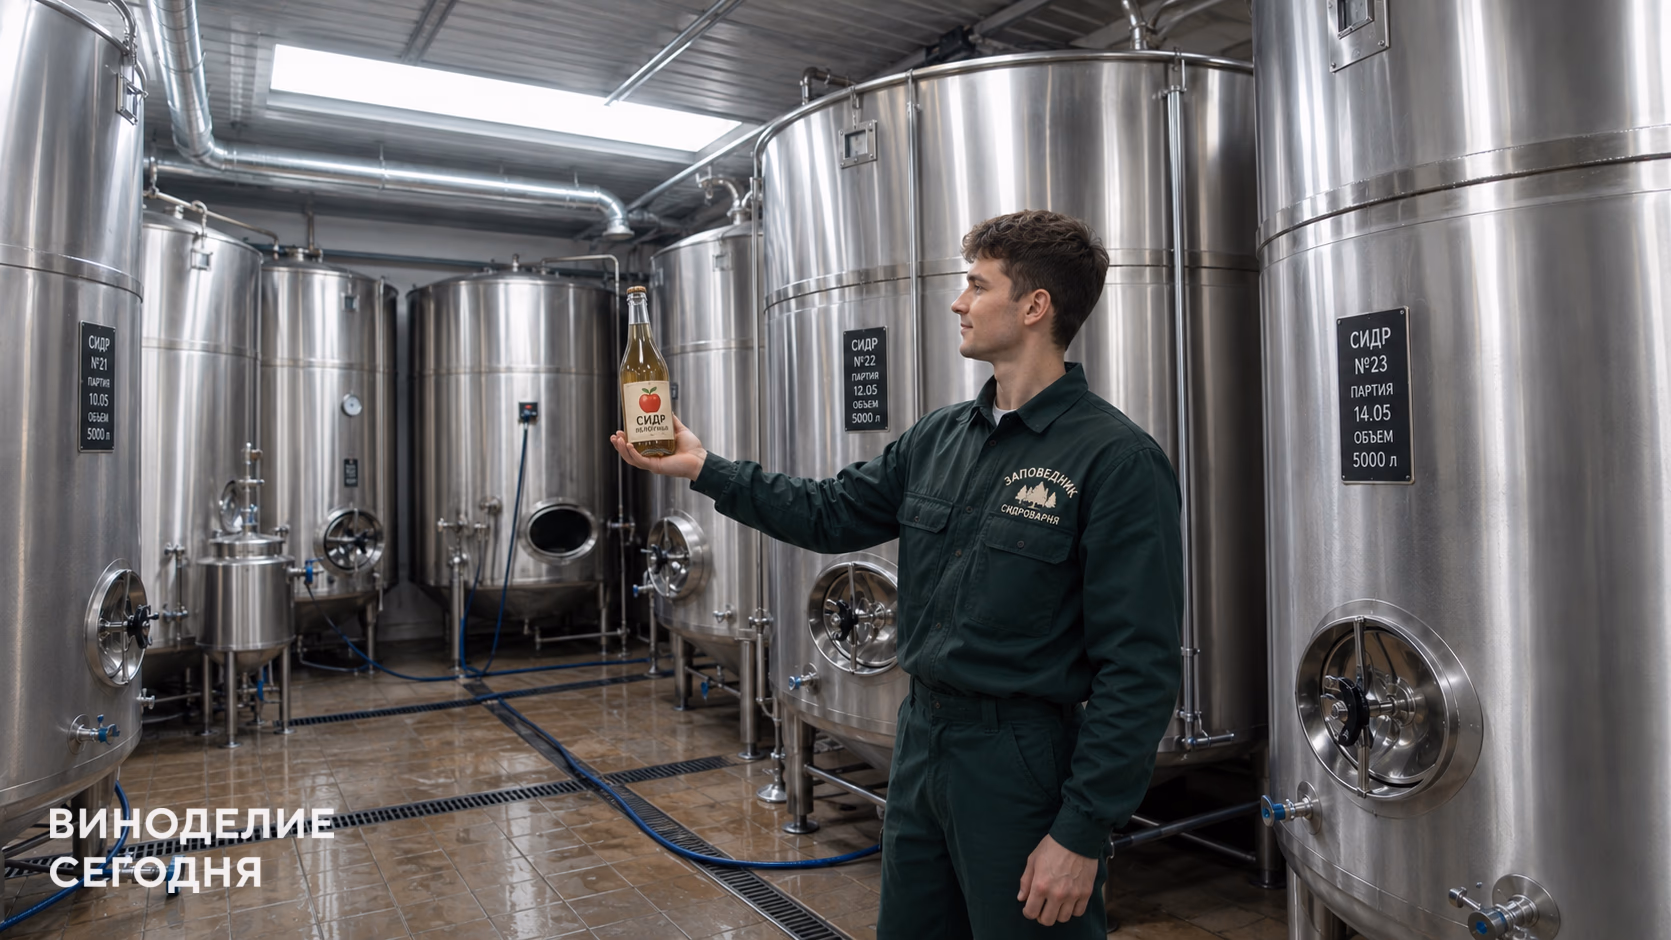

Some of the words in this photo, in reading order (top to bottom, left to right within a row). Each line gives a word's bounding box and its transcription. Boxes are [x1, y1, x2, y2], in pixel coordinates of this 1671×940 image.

[88, 335, 111, 353] СИДР
[851, 337, 878, 352] СИДР
[1350, 327, 1391, 350] СИДР
[851, 371, 879, 382] ПАРТИЯ
[854, 384, 878, 396] 12.05
[1350, 383, 1394, 399] ПАРТИЯ
[89, 393, 109, 407] 10.05
[636, 414, 666, 426] СИДР
[851, 412, 873, 424] 5000
[1353, 404, 1392, 423] 14.05
[87, 427, 105, 441] 5000
[1353, 430, 1394, 445] ОБЪЕМ
[1353, 451, 1386, 468] 5000
[1389, 455, 1398, 467] л
[1004, 467, 1079, 499] ЗАПОВЕДНИК
